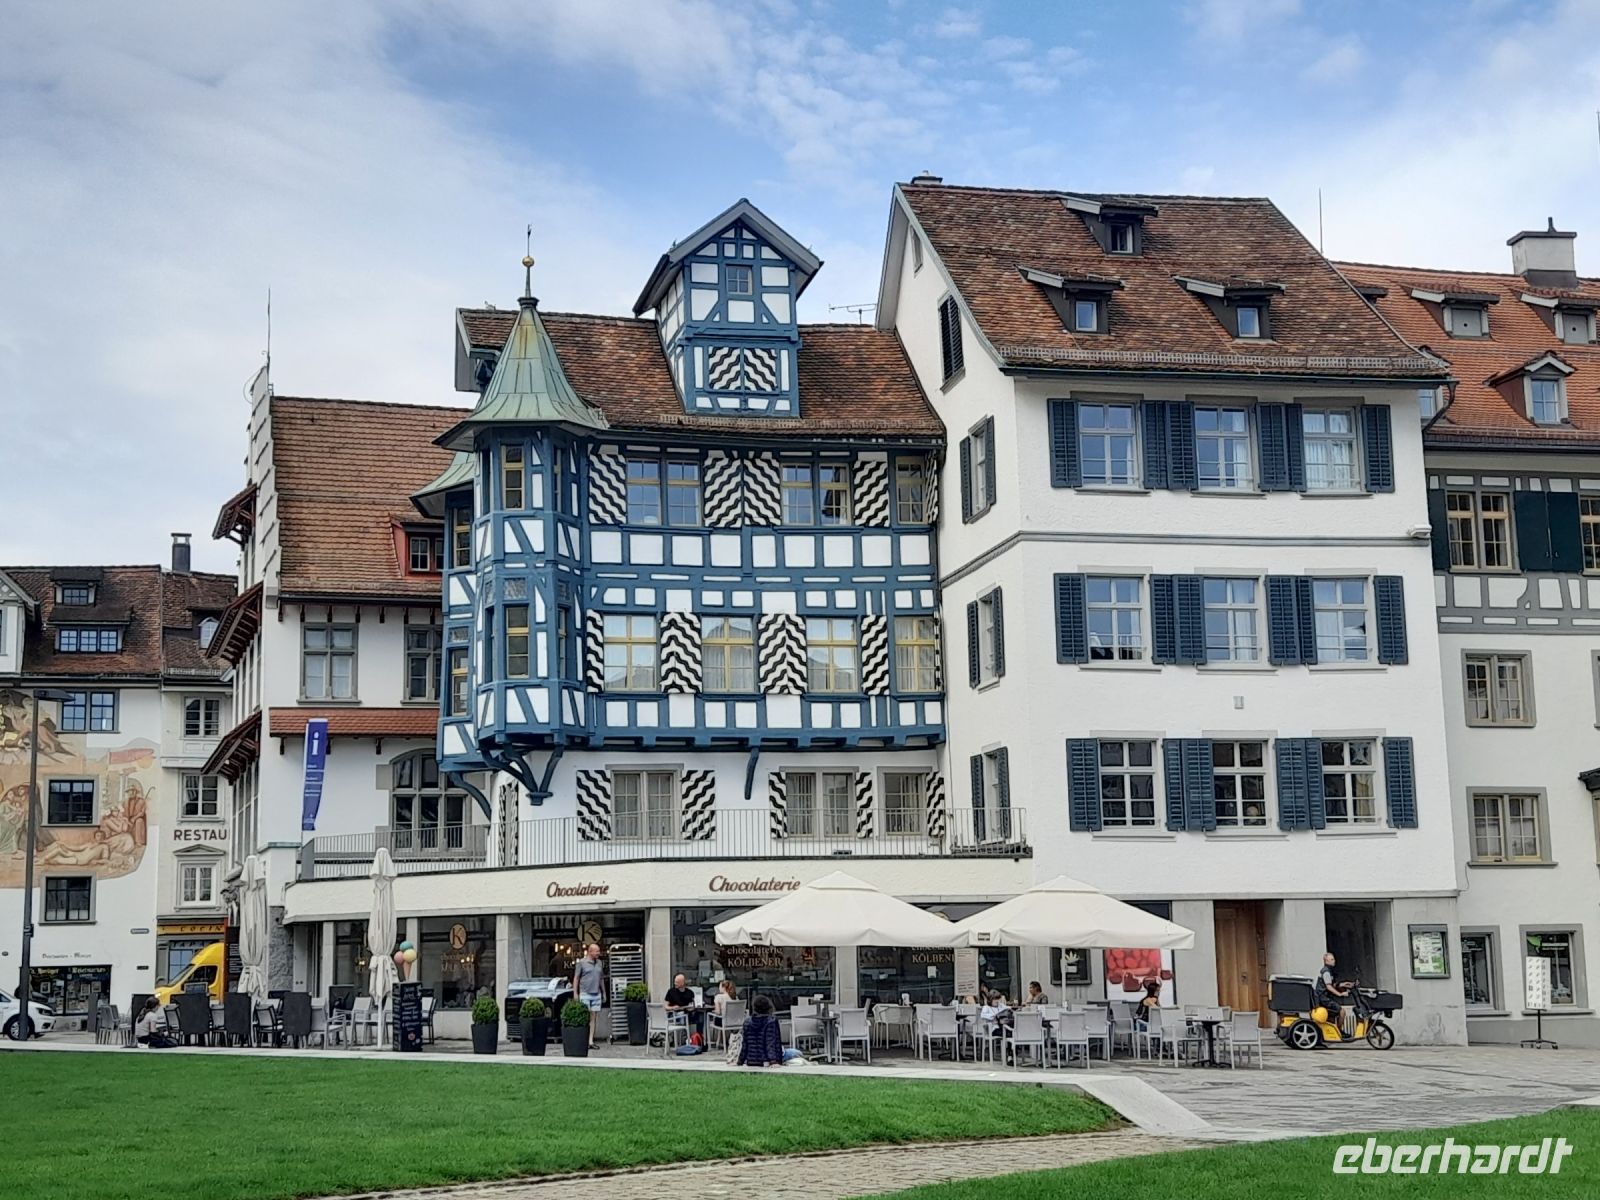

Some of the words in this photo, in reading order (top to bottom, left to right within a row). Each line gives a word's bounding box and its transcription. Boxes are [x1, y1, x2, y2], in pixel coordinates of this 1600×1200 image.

[173, 829, 230, 841] RESTAU
[546, 880, 610, 898] Chocolaterie
[708, 875, 801, 893] Chocolaterie
